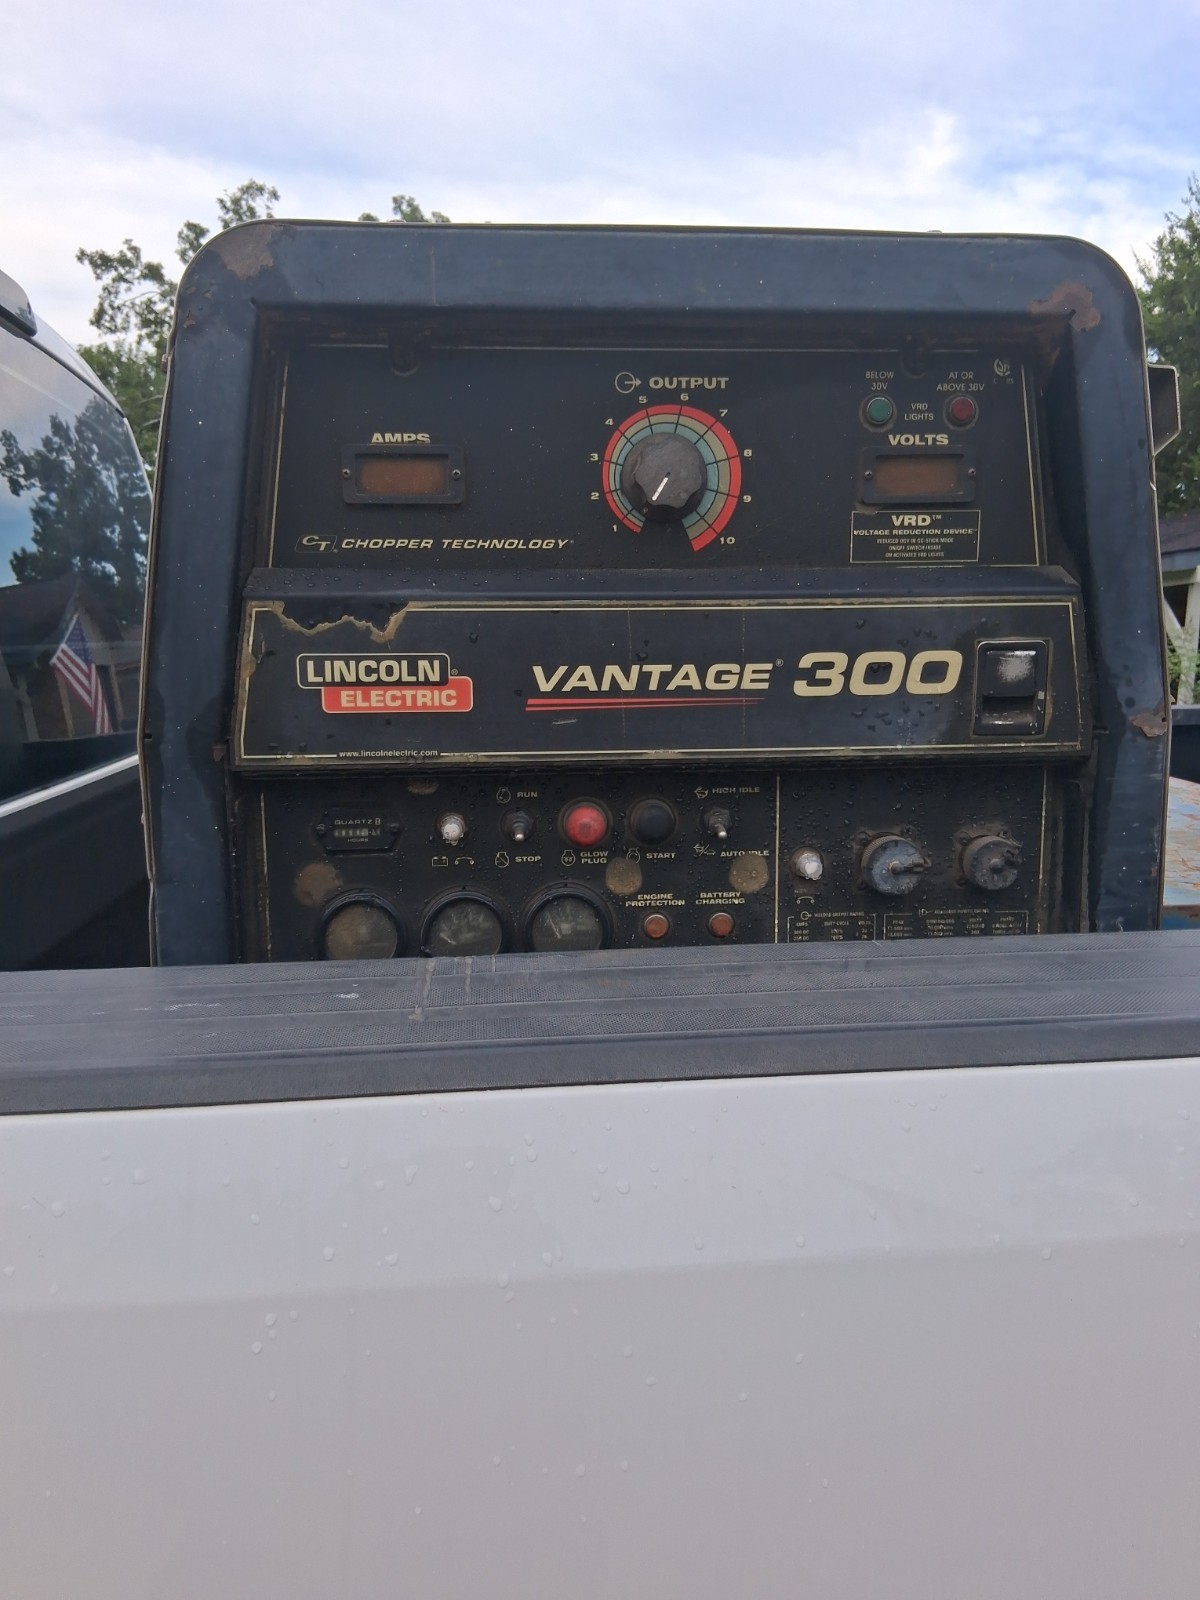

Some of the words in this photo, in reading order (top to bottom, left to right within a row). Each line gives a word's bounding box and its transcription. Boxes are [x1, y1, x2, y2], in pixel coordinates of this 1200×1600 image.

[865, 371, 895, 379] BELOW
[948, 371, 959, 379] AT
[961, 371, 974, 379] OR
[649, 376, 729, 389] OUTPUT
[871, 382, 888, 390] 30V
[936, 383, 966, 391] ABOVE
[968, 383, 985, 391] 30V
[680, 393, 689, 401] 6
[904, 413, 934, 421] LIGHTS
[604, 418, 614, 426] 4
[371, 432, 431, 444] AMPS
[888, 434, 949, 446] VOLTS
[590, 453, 599, 461] 3
[743, 449, 753, 457] 8
[590, 492, 600, 500] 2
[742, 495, 752, 503] 9
[612, 524, 618, 532] 1
[341, 539, 434, 549] CHOPPER
[442, 539, 569, 549] TECHNOLOGY
[793, 650, 963, 697] 300
[340, 689, 457, 708] ELECTRIC
[338, 749, 438, 758] www.lincolnelectric.com
[515, 855, 541, 863] STOP
[699, 891, 742, 899] BATTERY
[625, 899, 685, 907] PROTECTION
